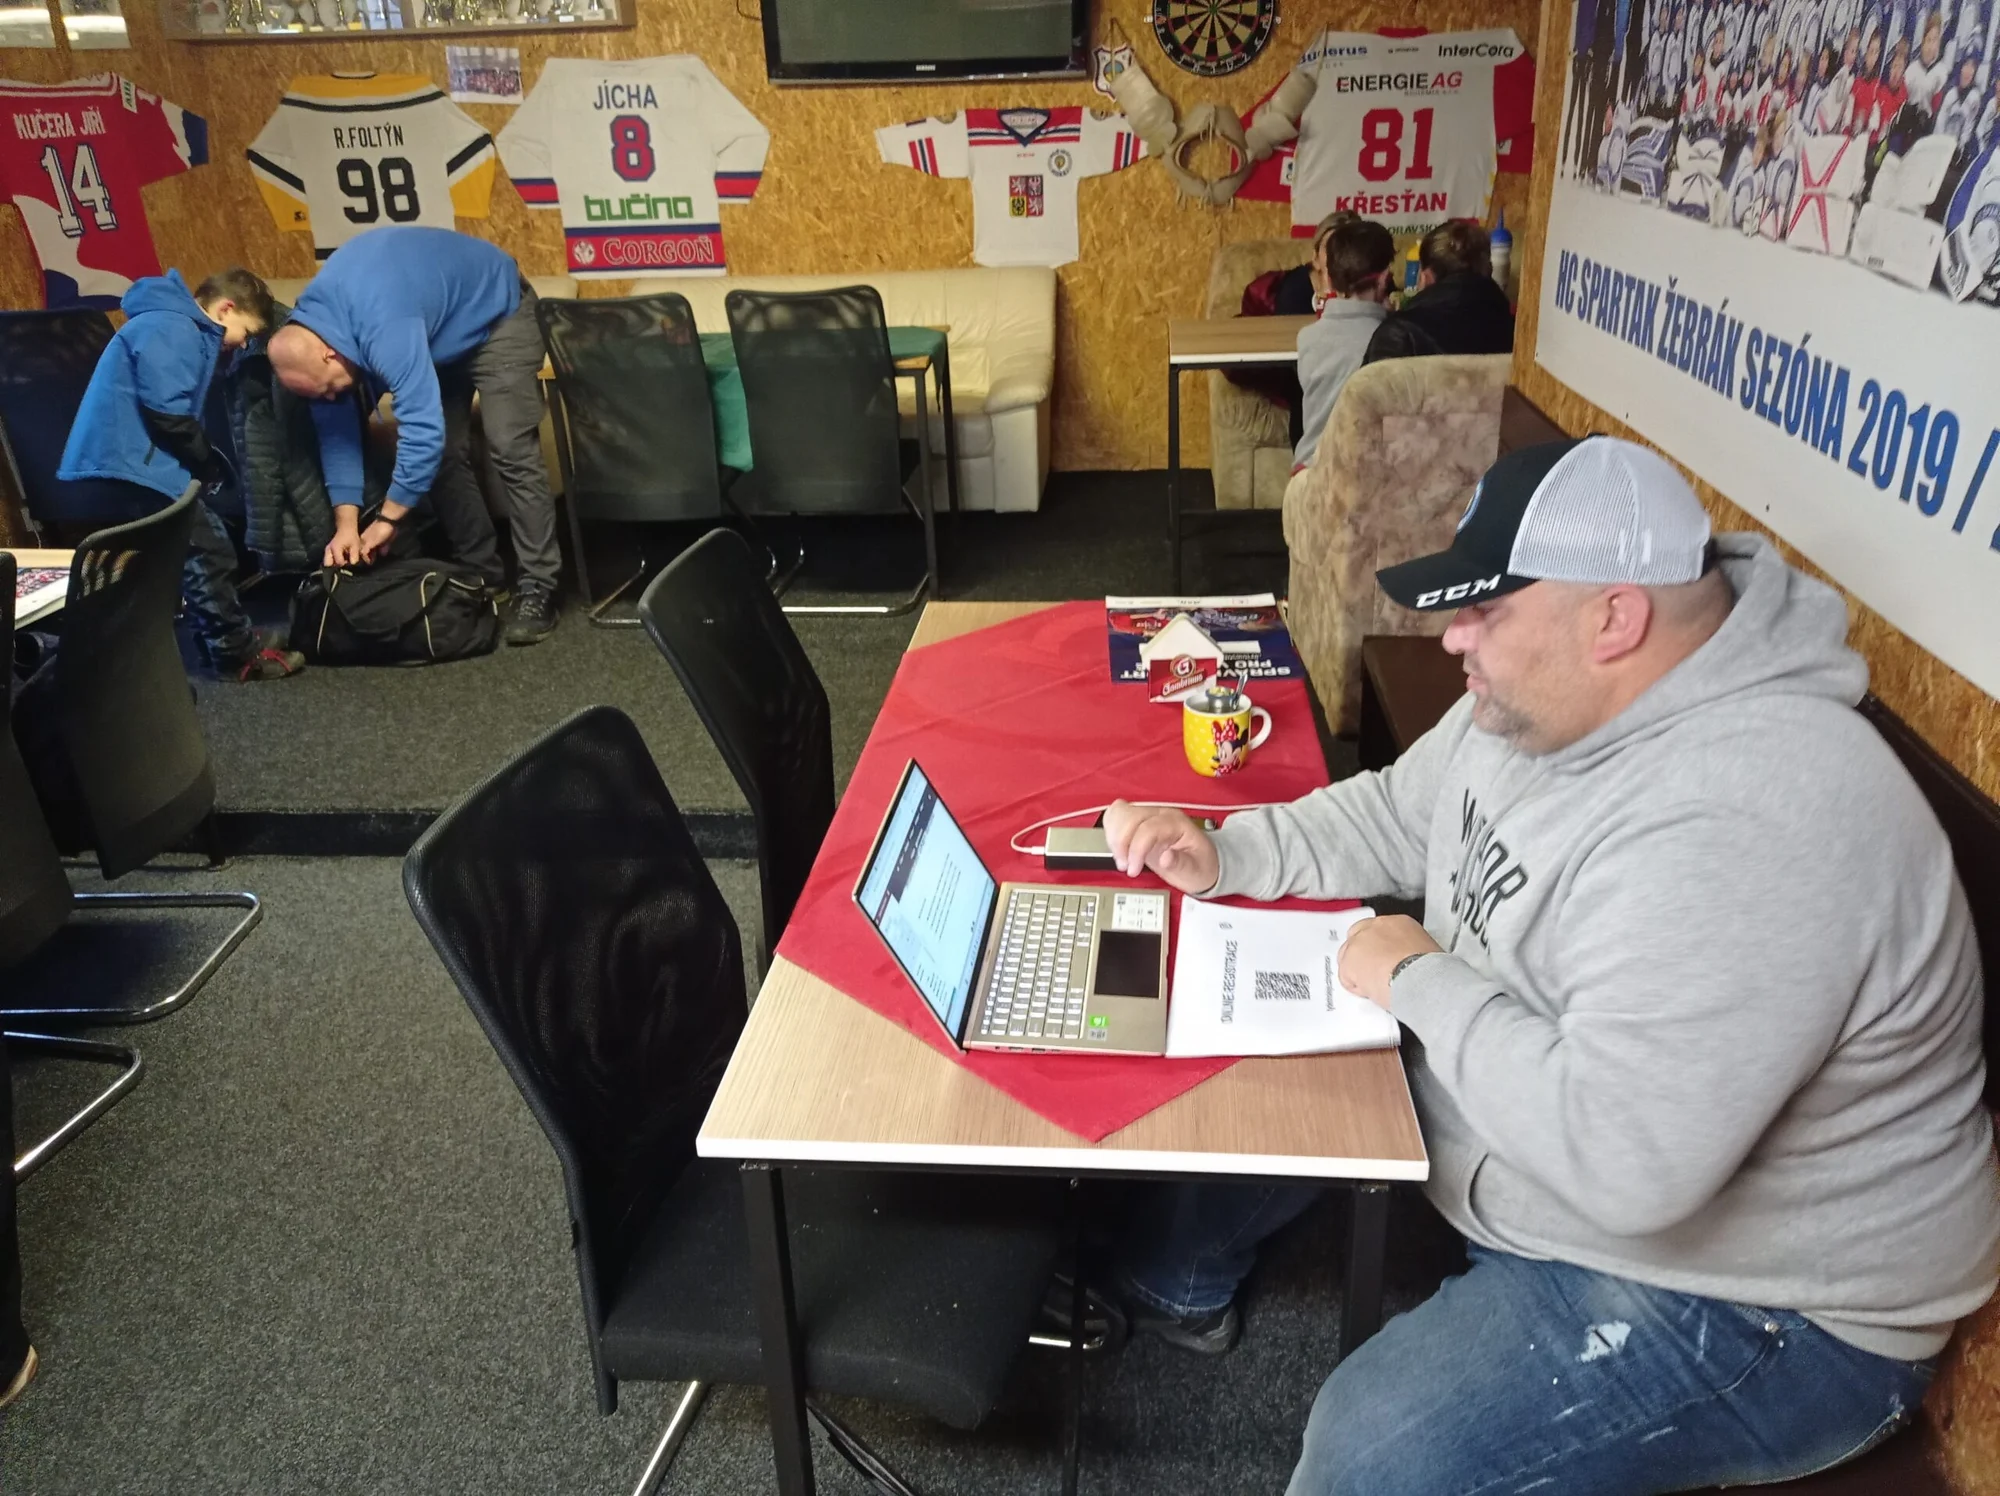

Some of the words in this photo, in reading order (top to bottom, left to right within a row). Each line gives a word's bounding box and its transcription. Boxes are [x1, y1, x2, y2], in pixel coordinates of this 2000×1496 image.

[593, 79, 659, 110] JÍCHA
[1336, 72, 1430, 94] ENERGIE
[1430, 71, 1463, 89] AG
[12, 108, 76, 140] KUČERA
[80, 105, 106, 136] JIŘÍ
[609, 114, 657, 183] 8
[1358, 107, 1434, 182] 81
[40, 142, 119, 239] 14
[336, 156, 421, 224] 98
[1335, 188, 1448, 215] KŘESŤAN
[1555, 249, 1579, 315] HC
[1576, 257, 1662, 353] SPARTAK
[1656, 275, 1745, 401] ŽEBRÁK
[1739, 332, 1851, 463] SEZÓNA
[1847, 377, 1961, 518] 2019
[1415, 573, 1501, 609] CCM
